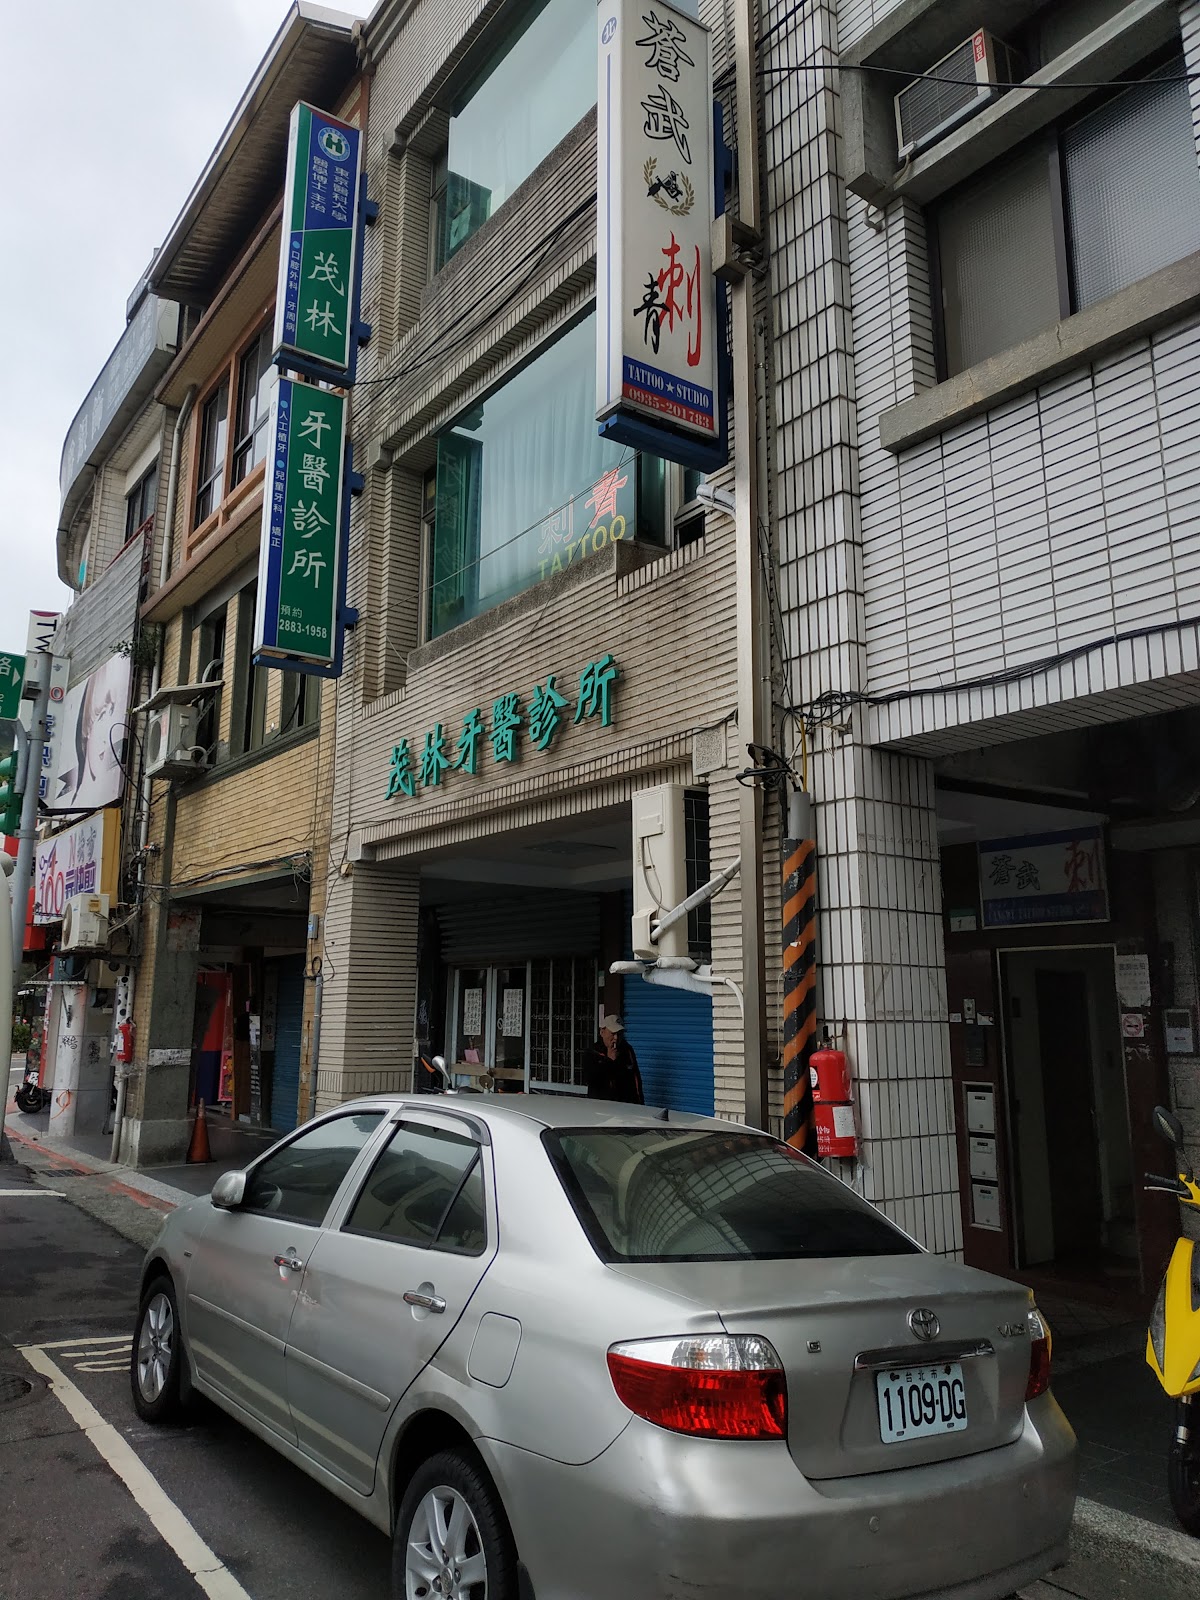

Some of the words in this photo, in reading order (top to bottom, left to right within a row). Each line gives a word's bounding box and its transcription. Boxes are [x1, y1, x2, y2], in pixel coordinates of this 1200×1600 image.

[331, 165, 350, 223] 東京醫科大學
[304, 250, 345, 338] 茂林
[633, 230, 702, 367] 刺青
[628, 363, 664, 391] TATTOO
[676, 383, 709, 409] STUDIO
[628, 387, 710, 428] 0935-201783
[277, 410, 288, 453] 人工植牙
[287, 410, 331, 589] 牙醫診所
[538, 515, 626, 580] TATTOO
[279, 618, 327, 639] 2883-1958
[280, 604, 303, 618] 預約
[384, 653, 620, 800] 茂林牙醫診所
[905, 1368, 938, 1383] 台北市
[883, 1378, 966, 1432] 1109-DG
